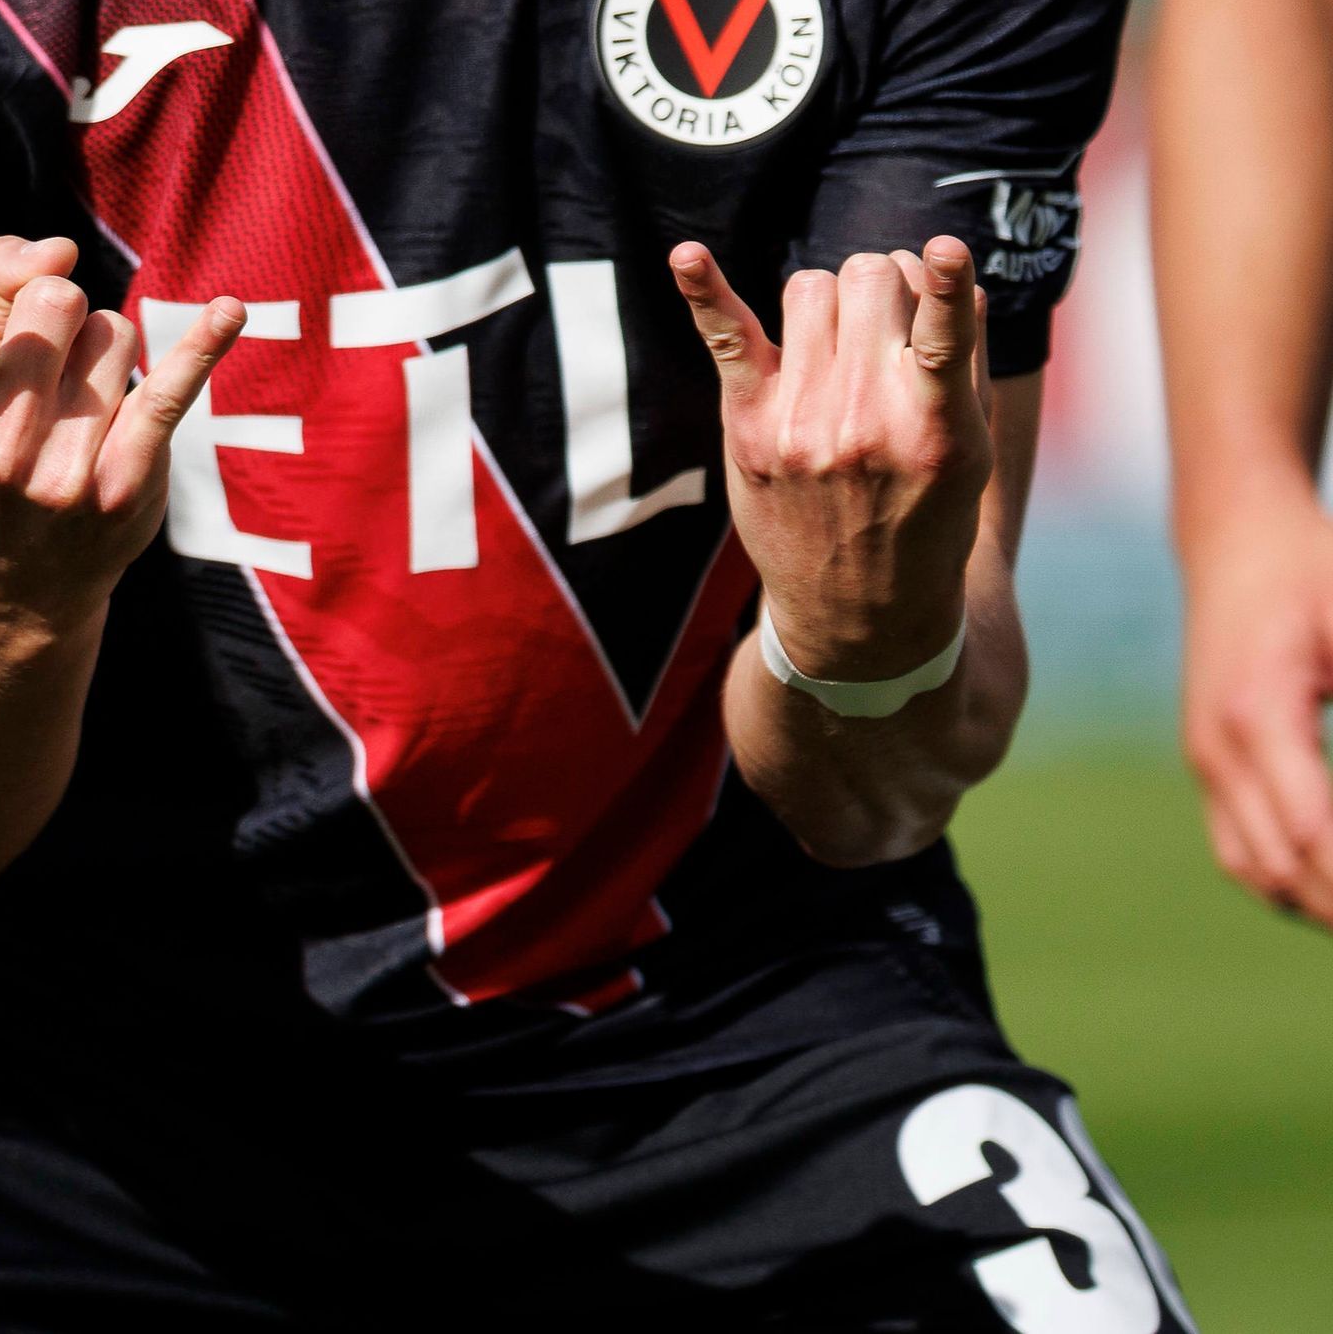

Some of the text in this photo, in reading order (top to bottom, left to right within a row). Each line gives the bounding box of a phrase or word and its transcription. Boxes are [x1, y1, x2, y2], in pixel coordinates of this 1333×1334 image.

[612, 10, 815, 135] VIKTORIA KÖLN
[140, 247, 706, 581] ETL
[896, 1083, 1200, 1334] 3
